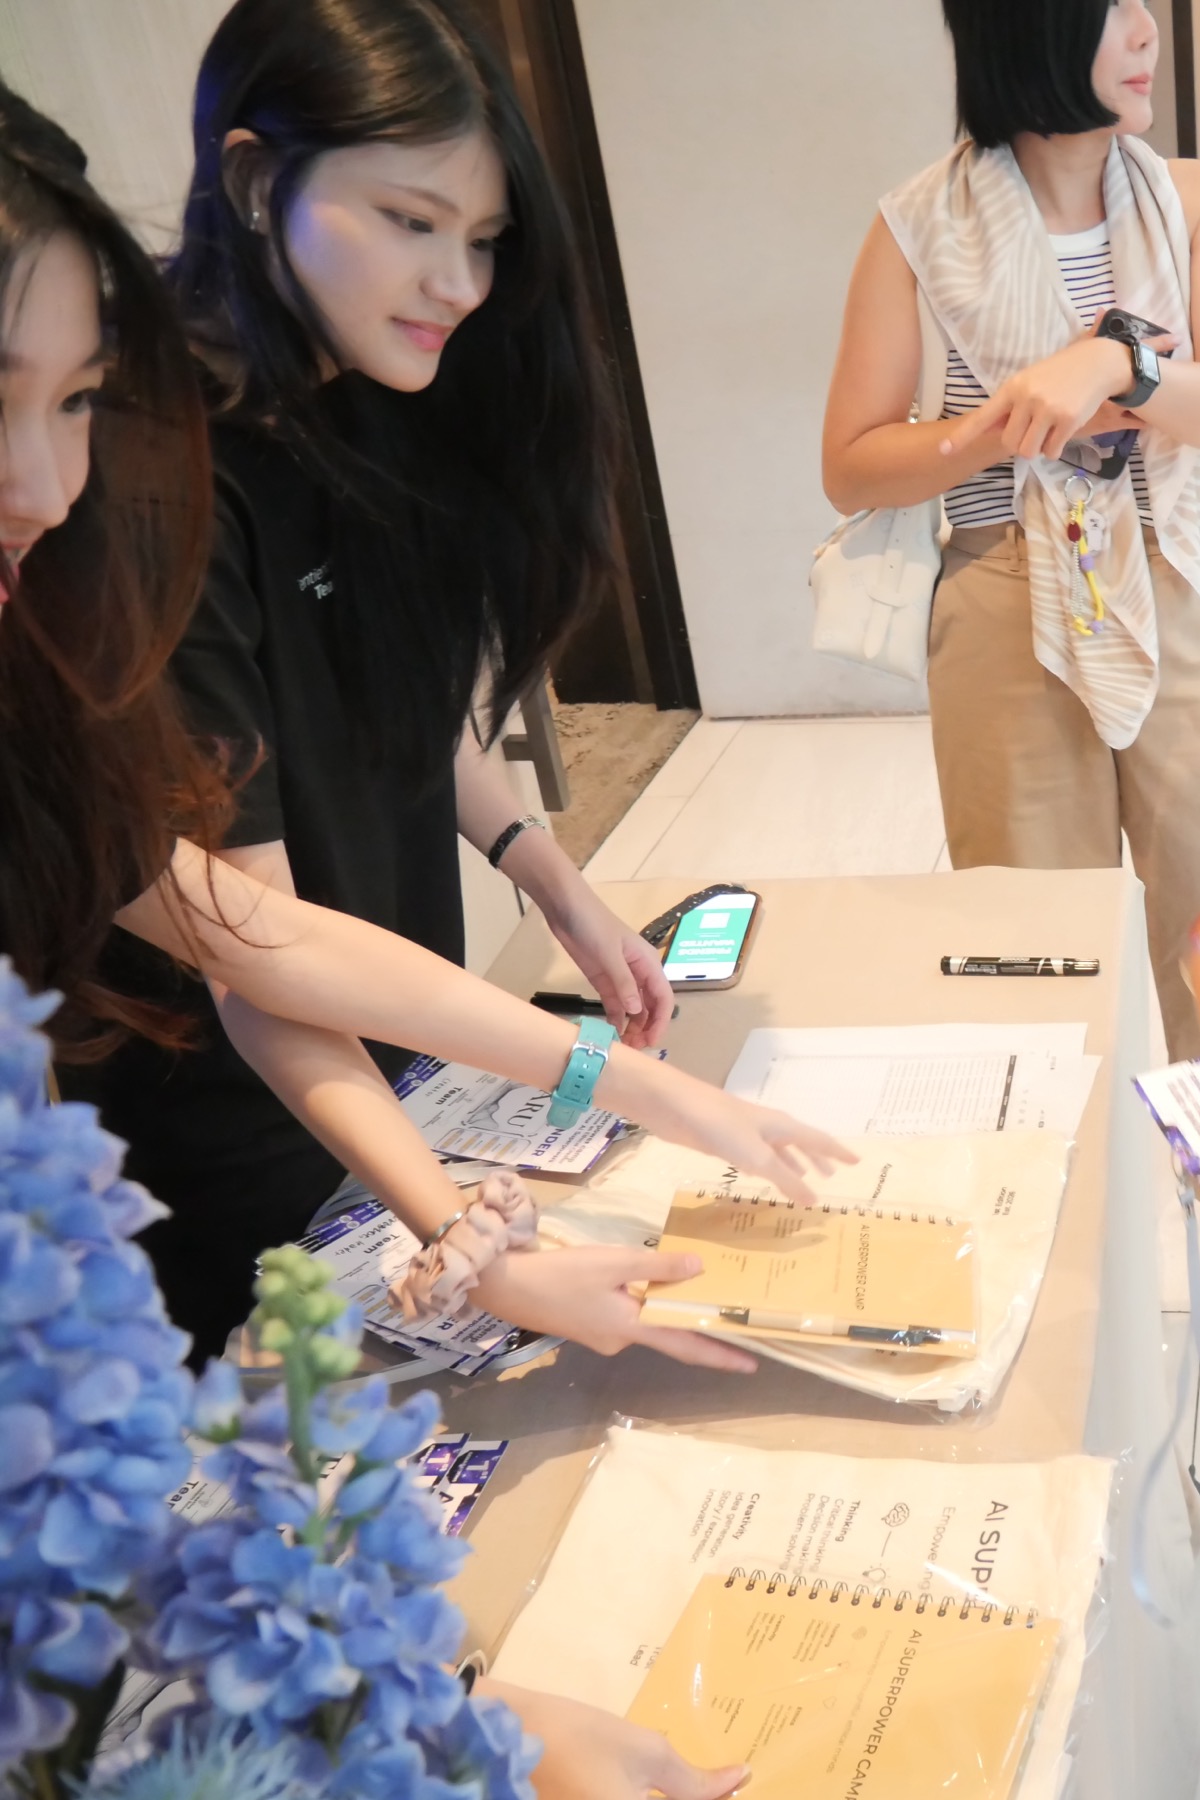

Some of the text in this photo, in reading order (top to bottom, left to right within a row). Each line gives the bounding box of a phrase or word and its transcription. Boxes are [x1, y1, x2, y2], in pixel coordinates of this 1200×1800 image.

[435, 1087, 464, 1105] Team
[506, 1089, 552, 1128] ARU
[532, 1128, 565, 1157] NDER
[363, 1233, 401, 1254] Team
[856, 1233, 870, 1285] SUPERPOWER
[690, 1489, 716, 1537] Innovation
[714, 1490, 732, 1514] Story
[732, 1493, 760, 1540] Creativity
[809, 1495, 830, 1533] Decision
[985, 1501, 1009, 1521] AI
[809, 1498, 844, 1572] Critical thinking
[835, 1500, 861, 1542] Thinking
[779, 1534, 798, 1571] solving
[630, 1644, 649, 1666] Lead
[908, 1629, 922, 1644] AI
[863, 1647, 916, 1755] SUPERPOWER
